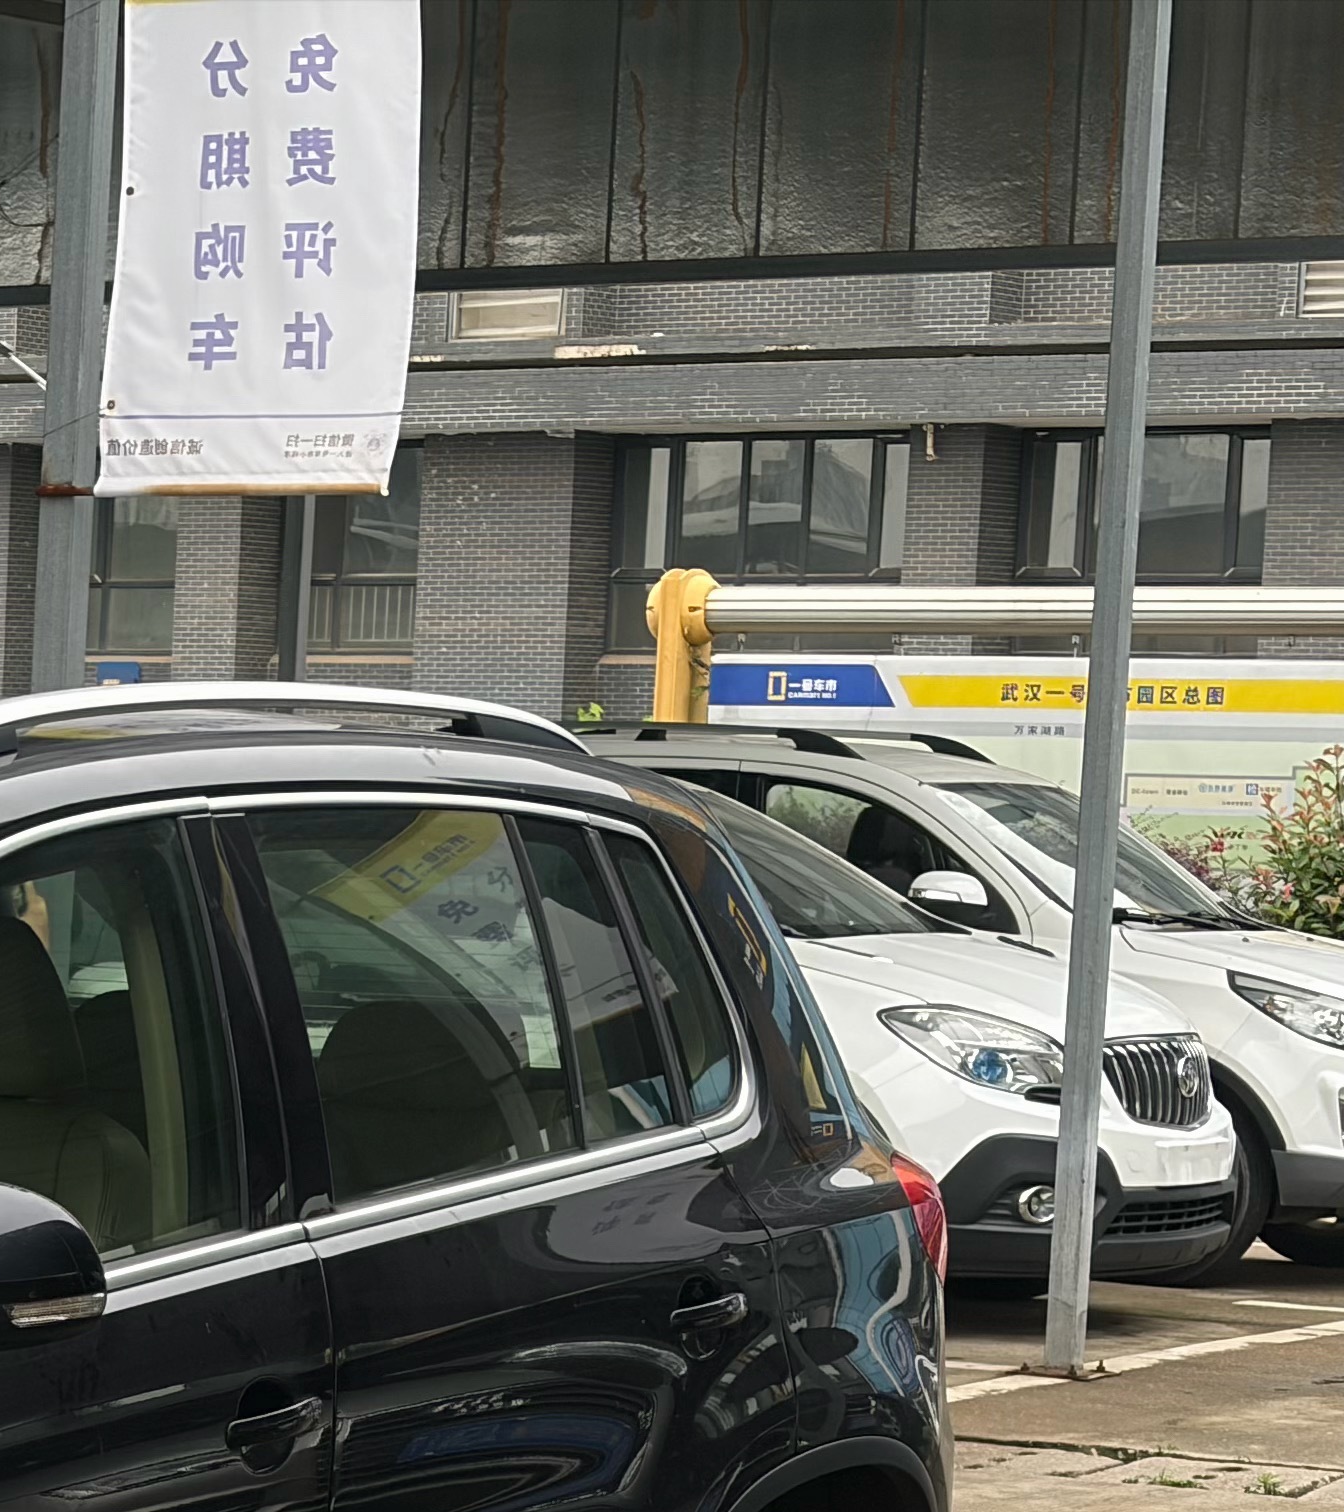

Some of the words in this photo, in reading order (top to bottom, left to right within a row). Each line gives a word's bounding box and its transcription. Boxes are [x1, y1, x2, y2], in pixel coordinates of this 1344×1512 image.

[788, 679, 838, 692] 一号车市
[1000, 682, 1225, 706] 武汉一号园区总图
